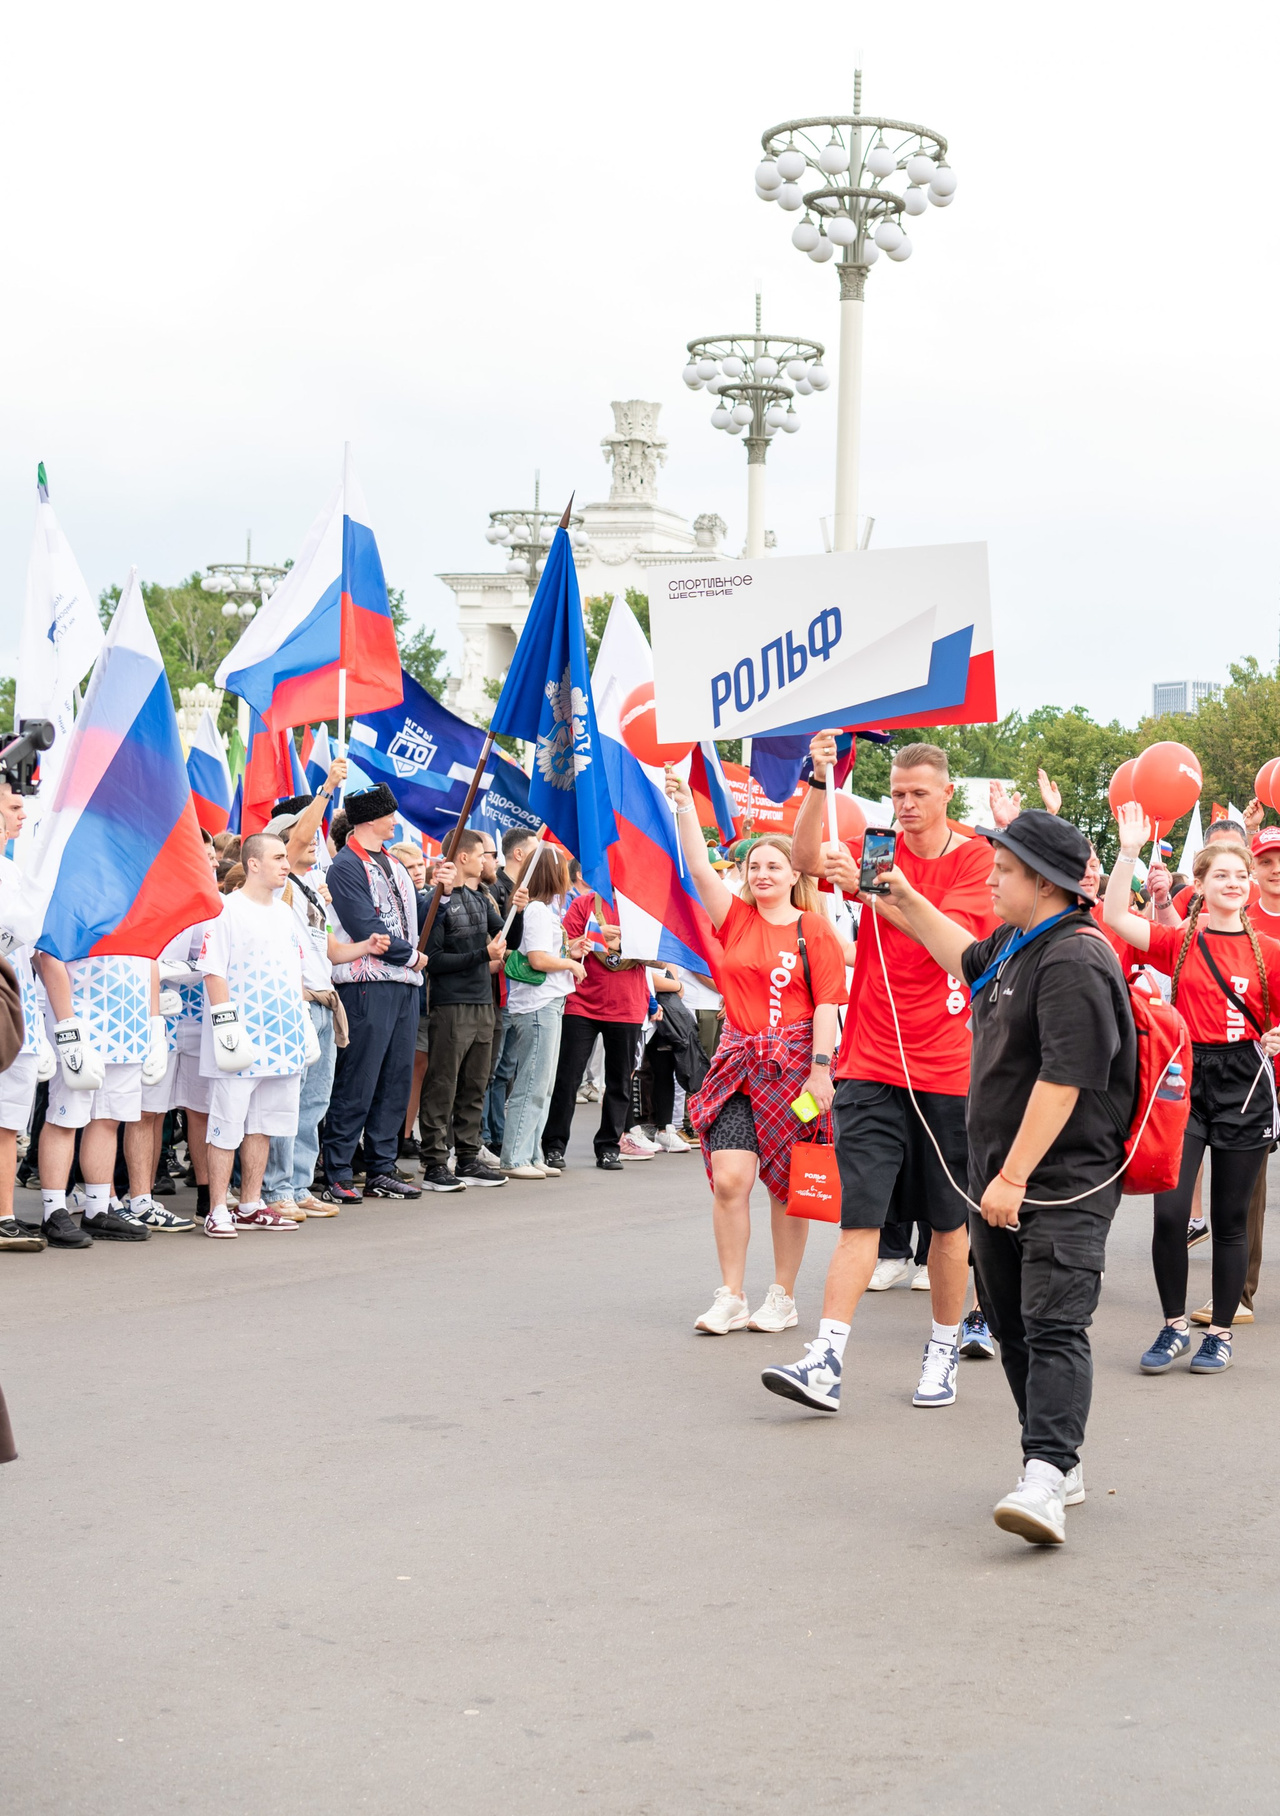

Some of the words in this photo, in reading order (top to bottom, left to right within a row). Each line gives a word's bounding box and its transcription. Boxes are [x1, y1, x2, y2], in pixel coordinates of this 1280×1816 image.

[668, 588, 734, 600] ШЕСТВИЕ
[710, 606, 842, 729] РОЛЬФ
[404, 716, 434, 743] ИГРЫ
[392, 737, 430, 764] ГТО
[487, 790, 542, 827] ЗДОРОВОЕ
[804, 1172, 827, 1181] РОЛЬФ
